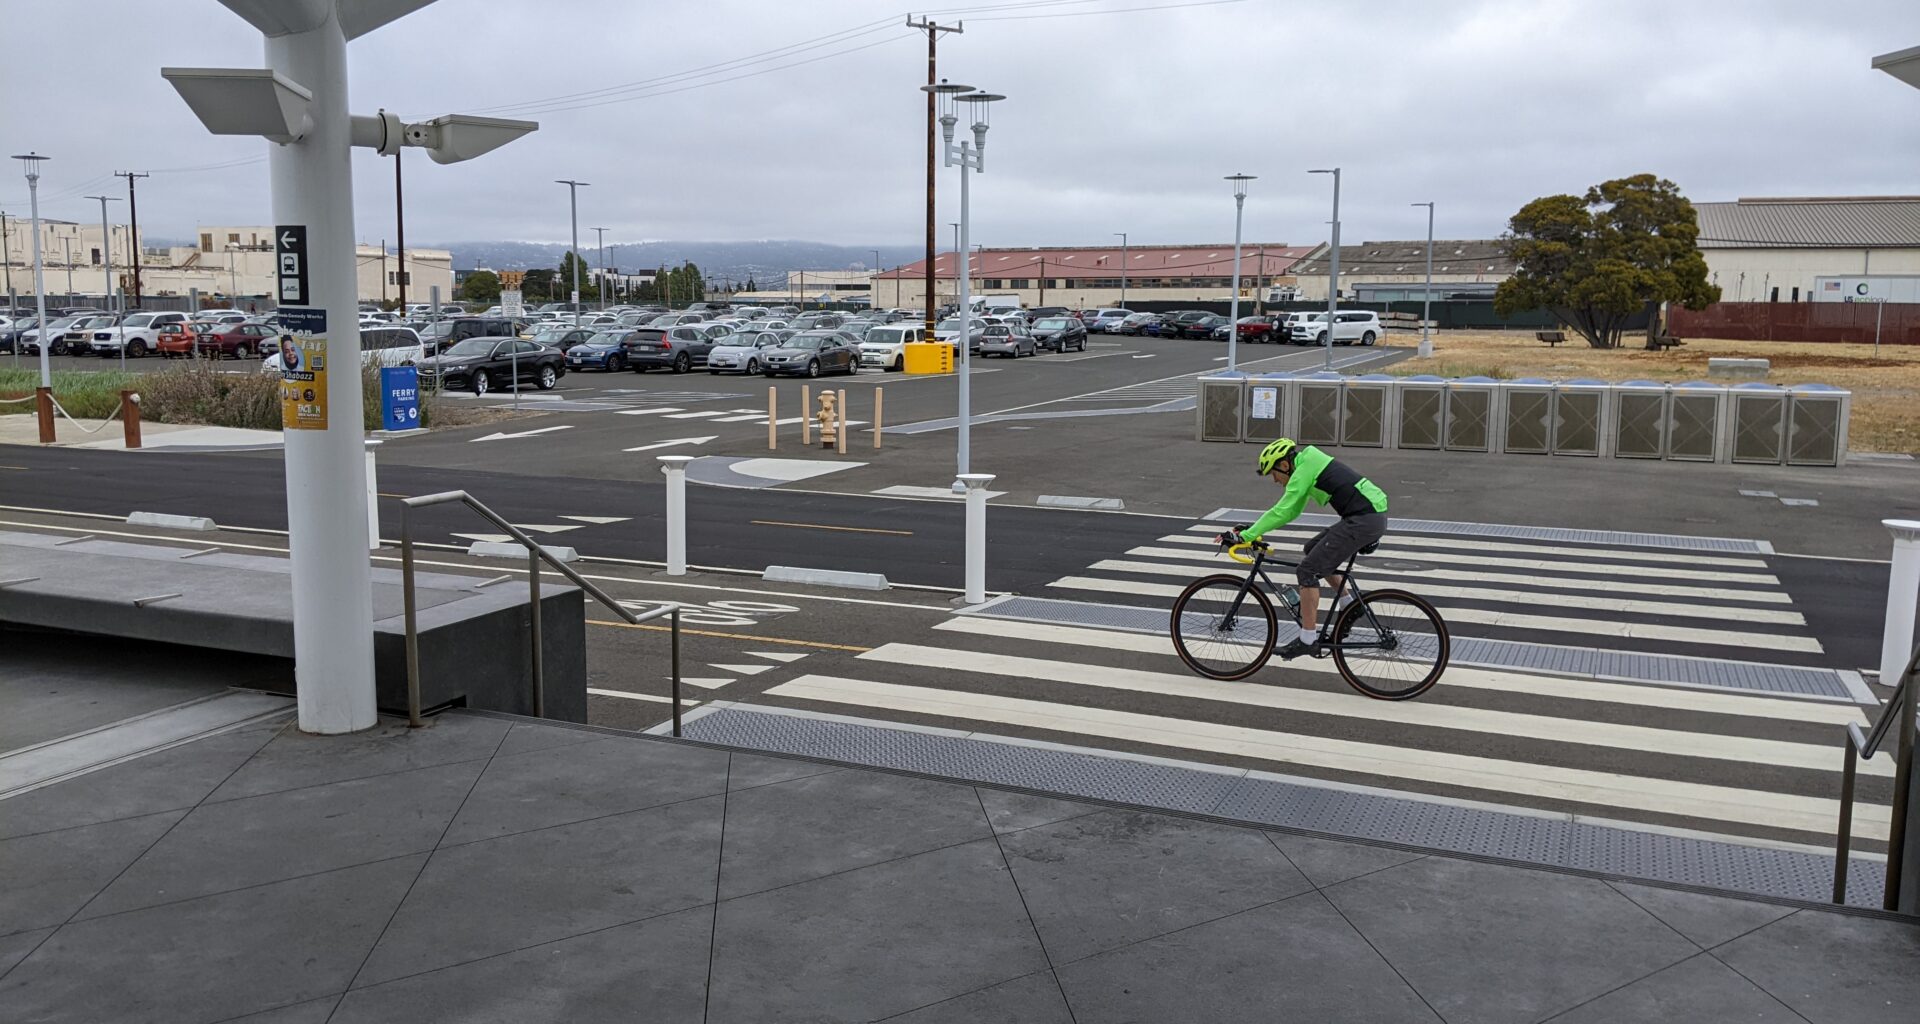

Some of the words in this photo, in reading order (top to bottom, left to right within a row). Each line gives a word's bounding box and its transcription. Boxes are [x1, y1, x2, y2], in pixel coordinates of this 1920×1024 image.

[296, 329, 312, 337] on
[301, 340, 326, 352] Tap
[392, 388, 416, 397] FERRY
